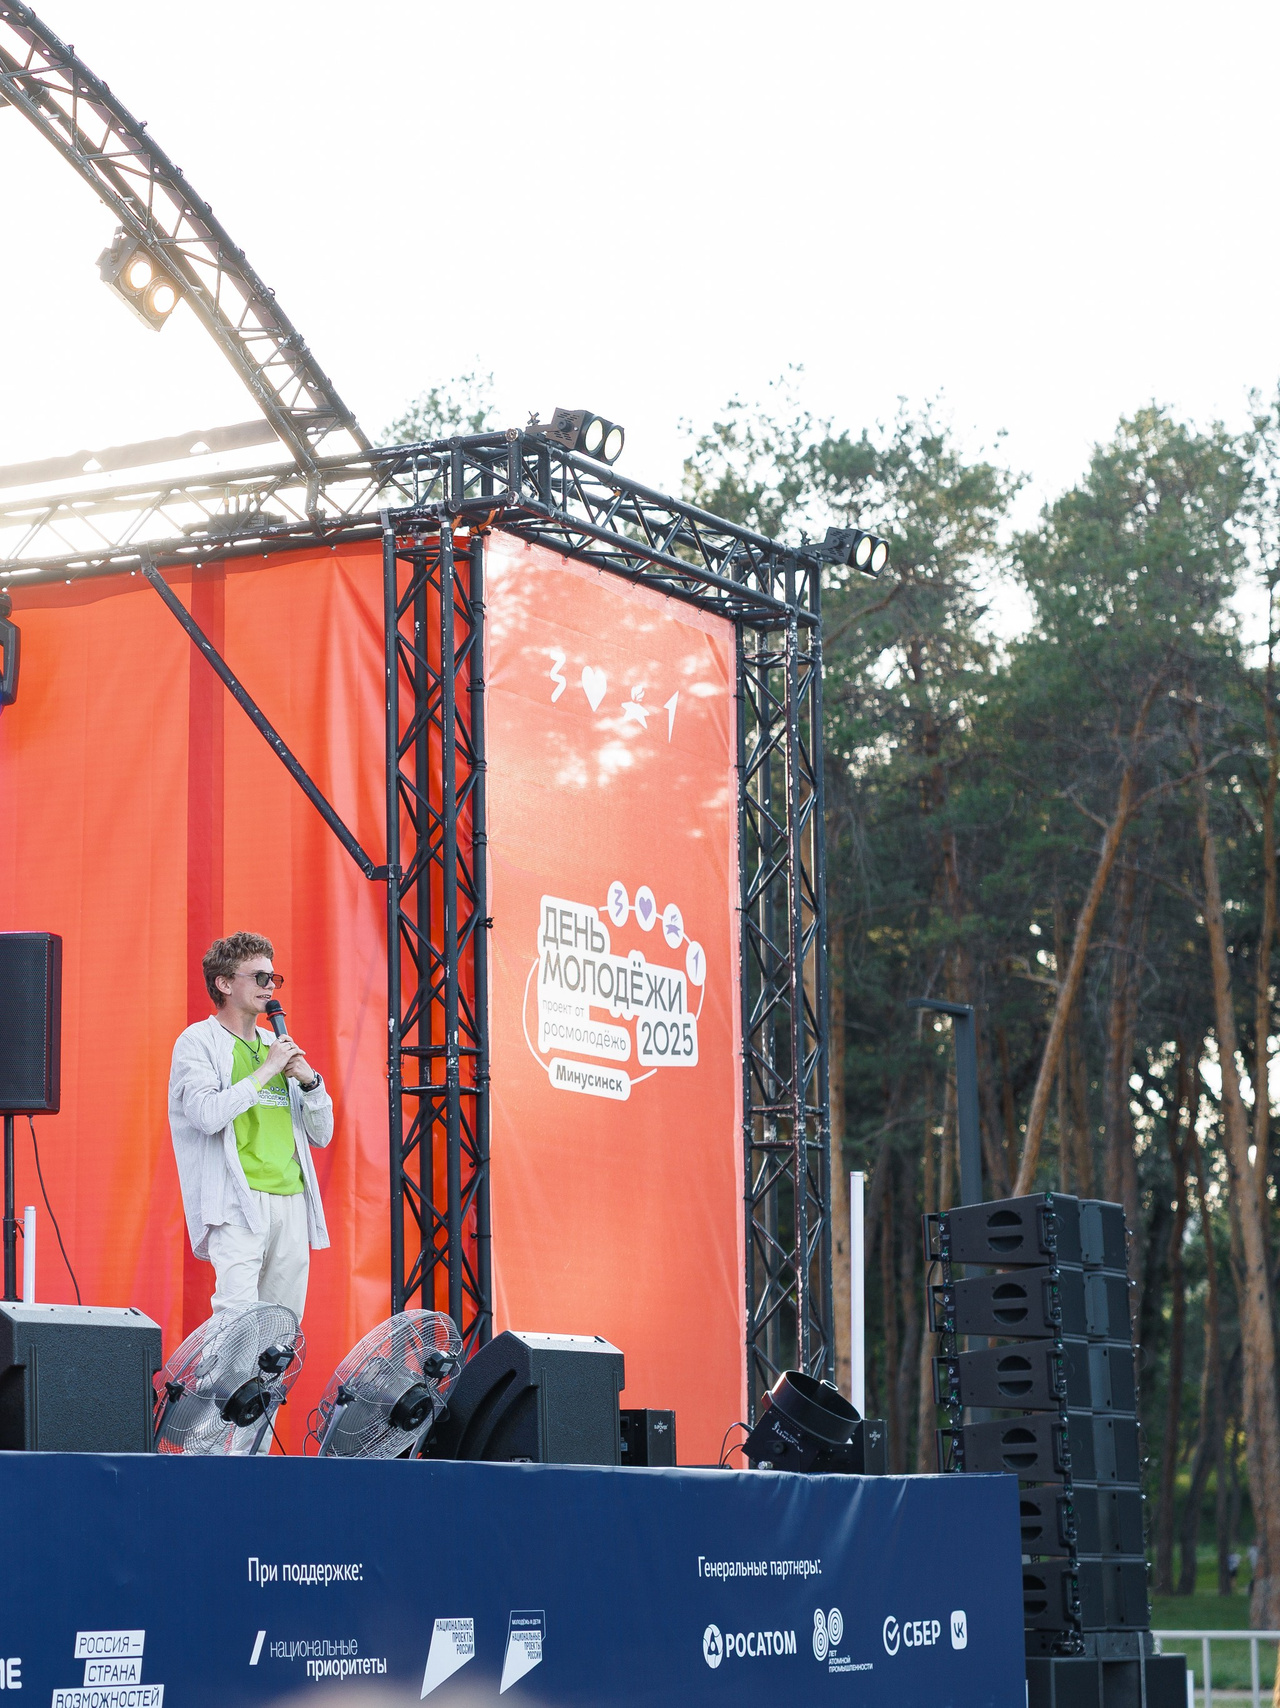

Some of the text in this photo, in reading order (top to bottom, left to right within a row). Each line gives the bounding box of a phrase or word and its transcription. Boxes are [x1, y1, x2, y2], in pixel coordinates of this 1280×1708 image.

[543, 905, 606, 954] ДЕНЬ
[543, 950, 683, 1015] МОЛОДЁЖИ
[542, 998, 584, 1017] проект от
[544, 1020, 627, 1051] росмолодёжь
[641, 1021, 694, 1056] 2025
[556, 1064, 623, 1092] Минусинск
[248, 1557, 363, 1588] При поддержке:
[698, 1556, 822, 1582] Генеральные партнеры:
[435, 1619, 473, 1632] НАЦИОНАЛЬНЫЕ
[452, 1631, 474, 1643] ПРОЕКТЫ
[511, 1632, 541, 1641] НАЦИОНАЛЬНЫЕ
[812, 1607, 844, 1661] 80
[903, 1619, 941, 1648] СБЕР
[79, 1636, 130, 1654] РОССИЯ
[270, 1638, 358, 1661] национальные
[456, 1643, 474, 1655] РОССИИ
[523, 1641, 541, 1650] ПРОЕКТЫ
[527, 1650, 541, 1660] РОССИИ
[725, 1630, 797, 1658] РОСАТОМ
[88, 1664, 137, 1682] СТРАНА
[307, 1657, 387, 1681] приоритеты
[55, 1686, 161, 1708] ВОЗМОЖНОСТЕЙ
